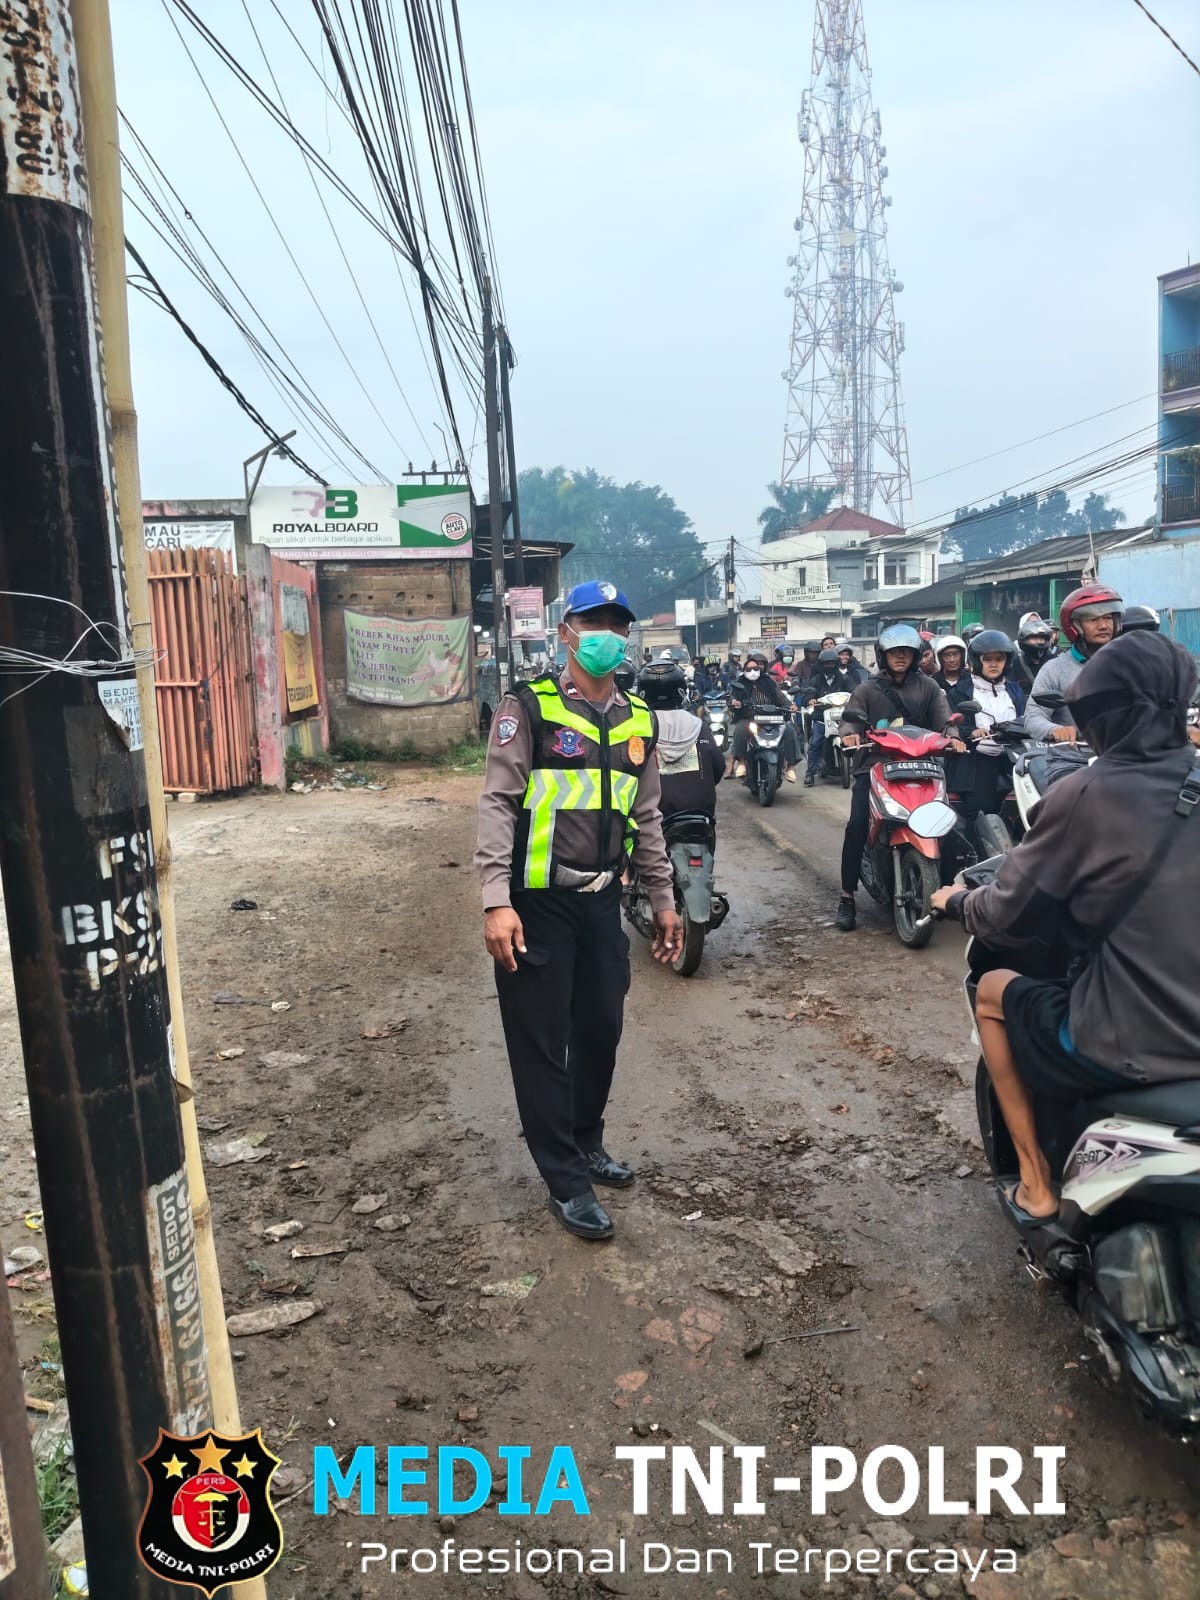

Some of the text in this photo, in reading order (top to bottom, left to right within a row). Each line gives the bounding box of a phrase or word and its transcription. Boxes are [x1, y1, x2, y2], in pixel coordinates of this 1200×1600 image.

[273, 522, 378, 534] ROYALBOARD
[446, 520, 463, 529] AUTO
[447, 525, 464, 533] CLAVE
[144, 525, 181, 537] MAU
[144, 537, 181, 549] CARI
[308, 535, 330, 544] untuk
[355, 629, 450, 643] BEBEK KHAS MADURA
[356, 641, 416, 655] AYAM PENYET
[369, 662, 397, 673] JERUK
[369, 672, 386, 681] TEH
[388, 675, 416, 684] MANIS
[161, 1197, 181, 1262] SEDOT
